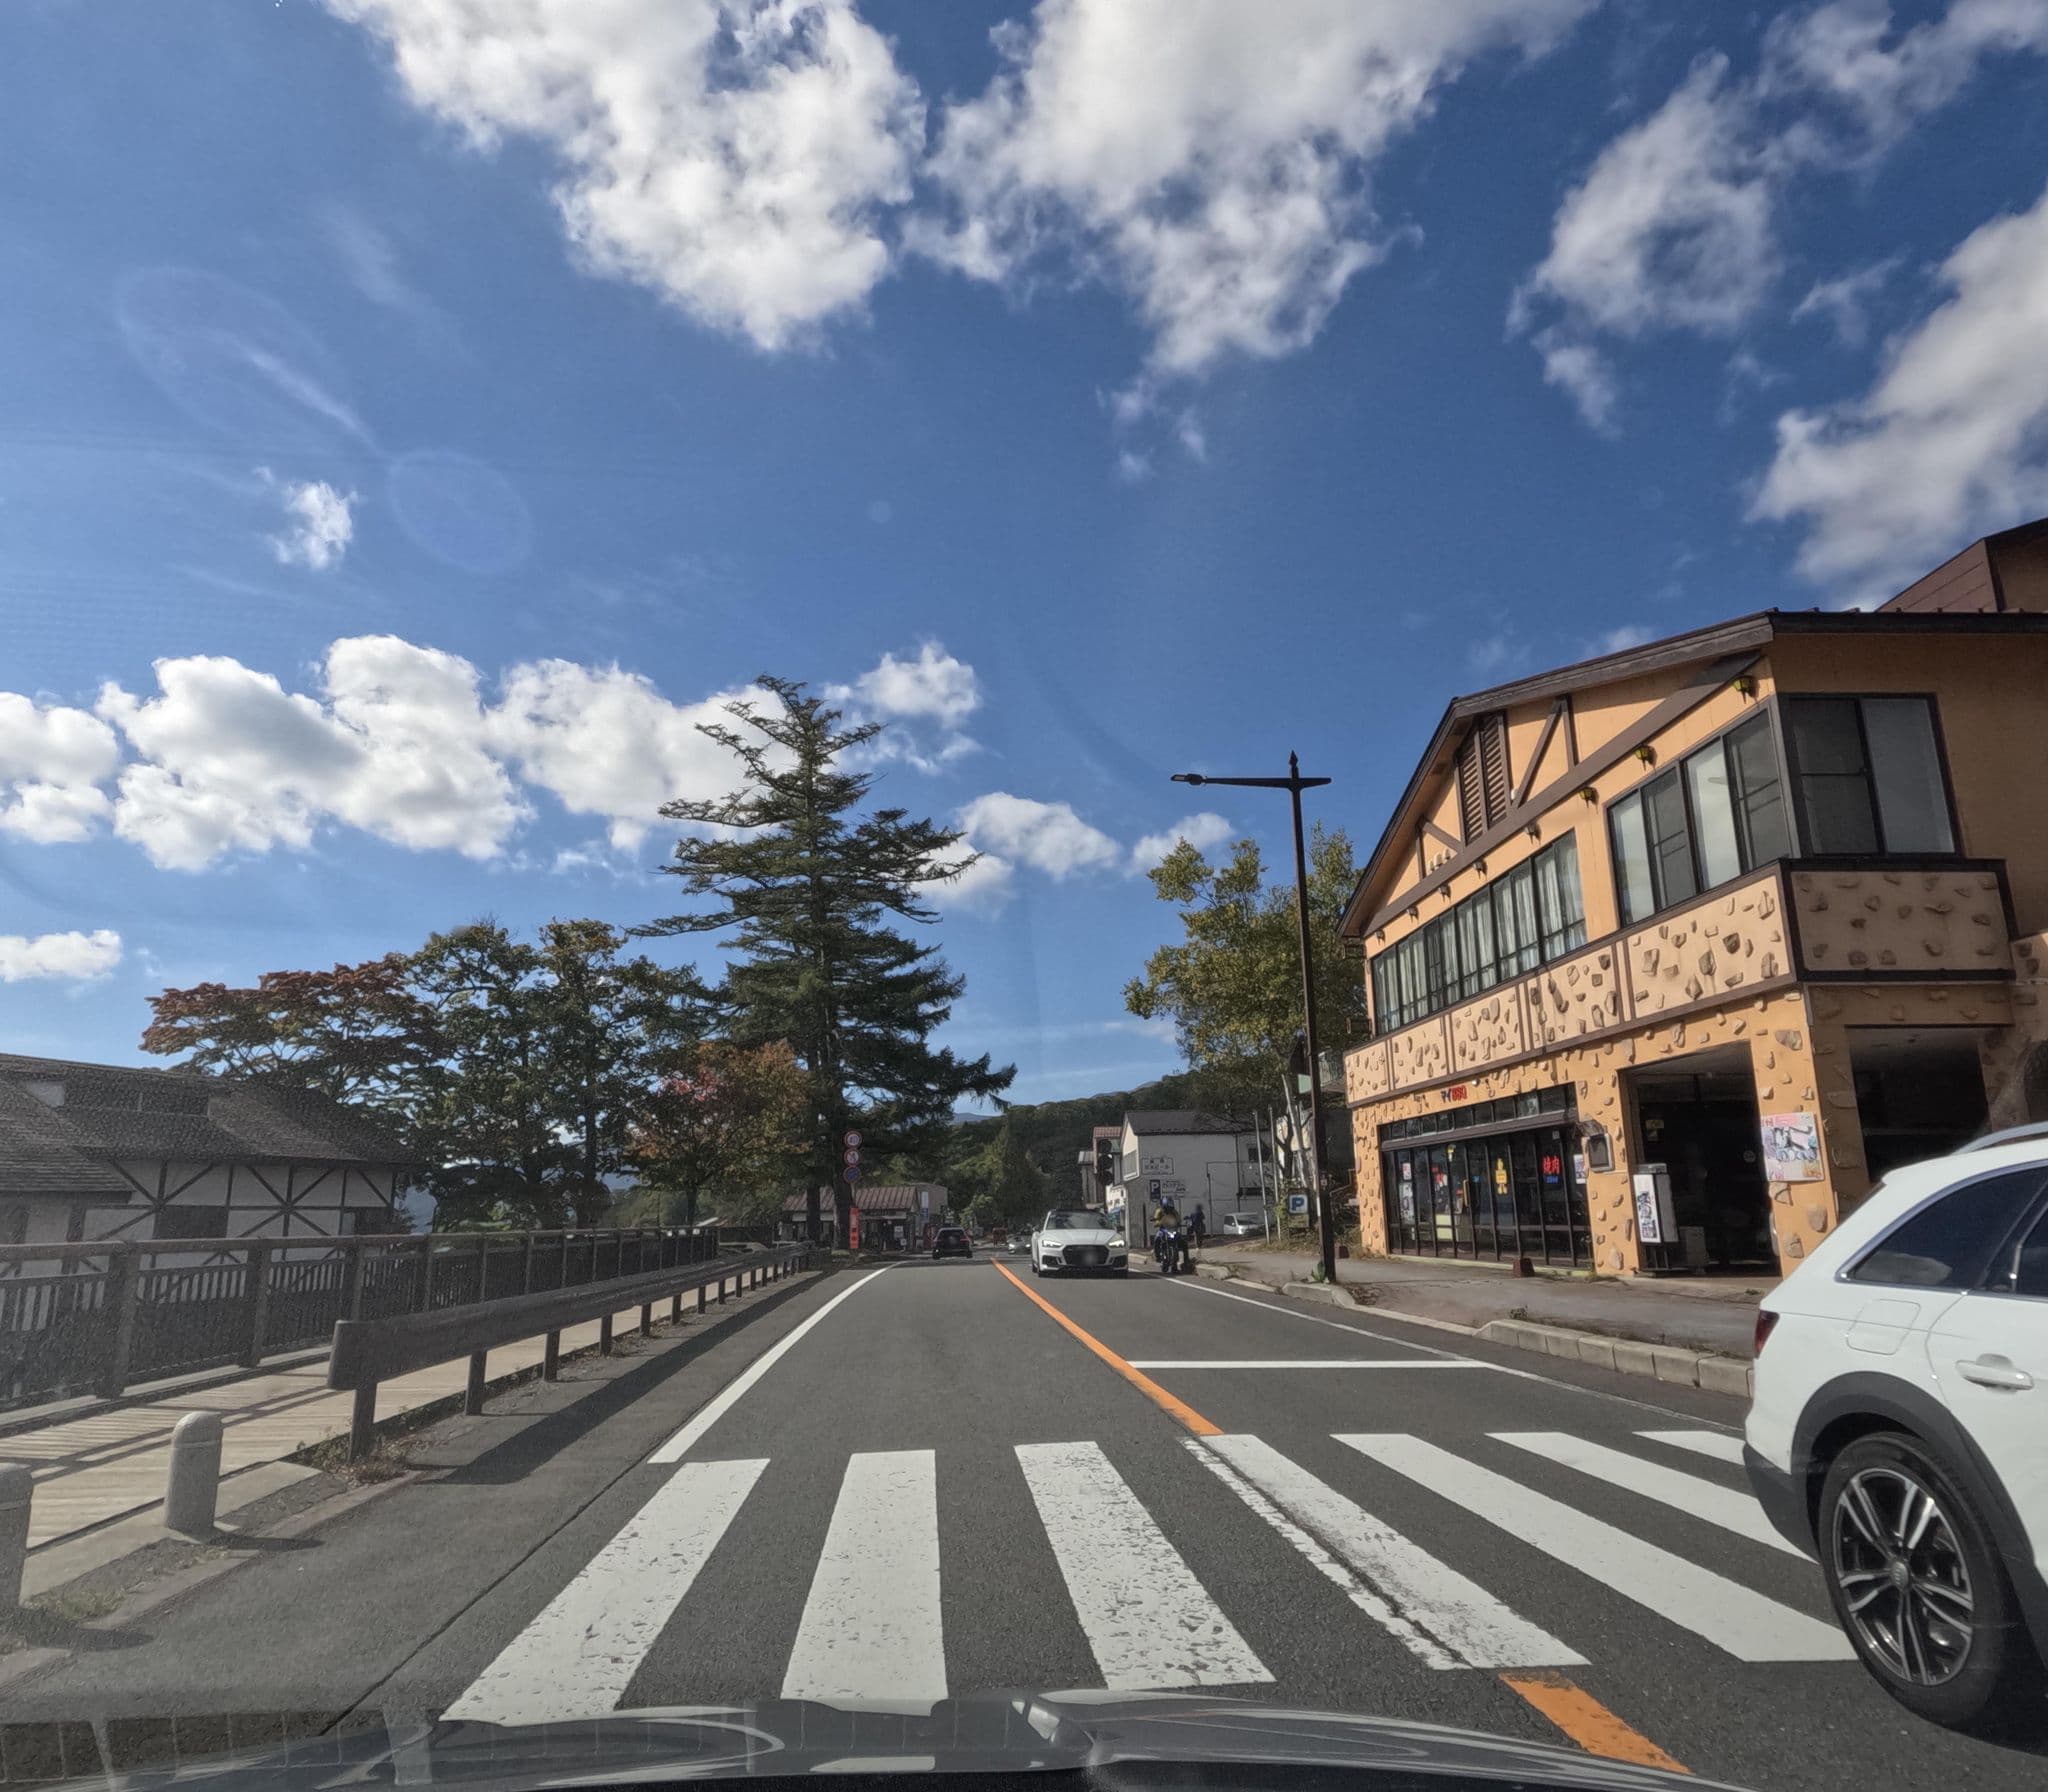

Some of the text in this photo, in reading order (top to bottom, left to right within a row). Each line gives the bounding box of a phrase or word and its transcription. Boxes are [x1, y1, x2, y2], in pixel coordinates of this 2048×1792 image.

[1543, 1155, 1560, 1174] 焼肉
[1151, 1182, 1159, 1193] P
[1292, 1197, 1305, 1211] P
